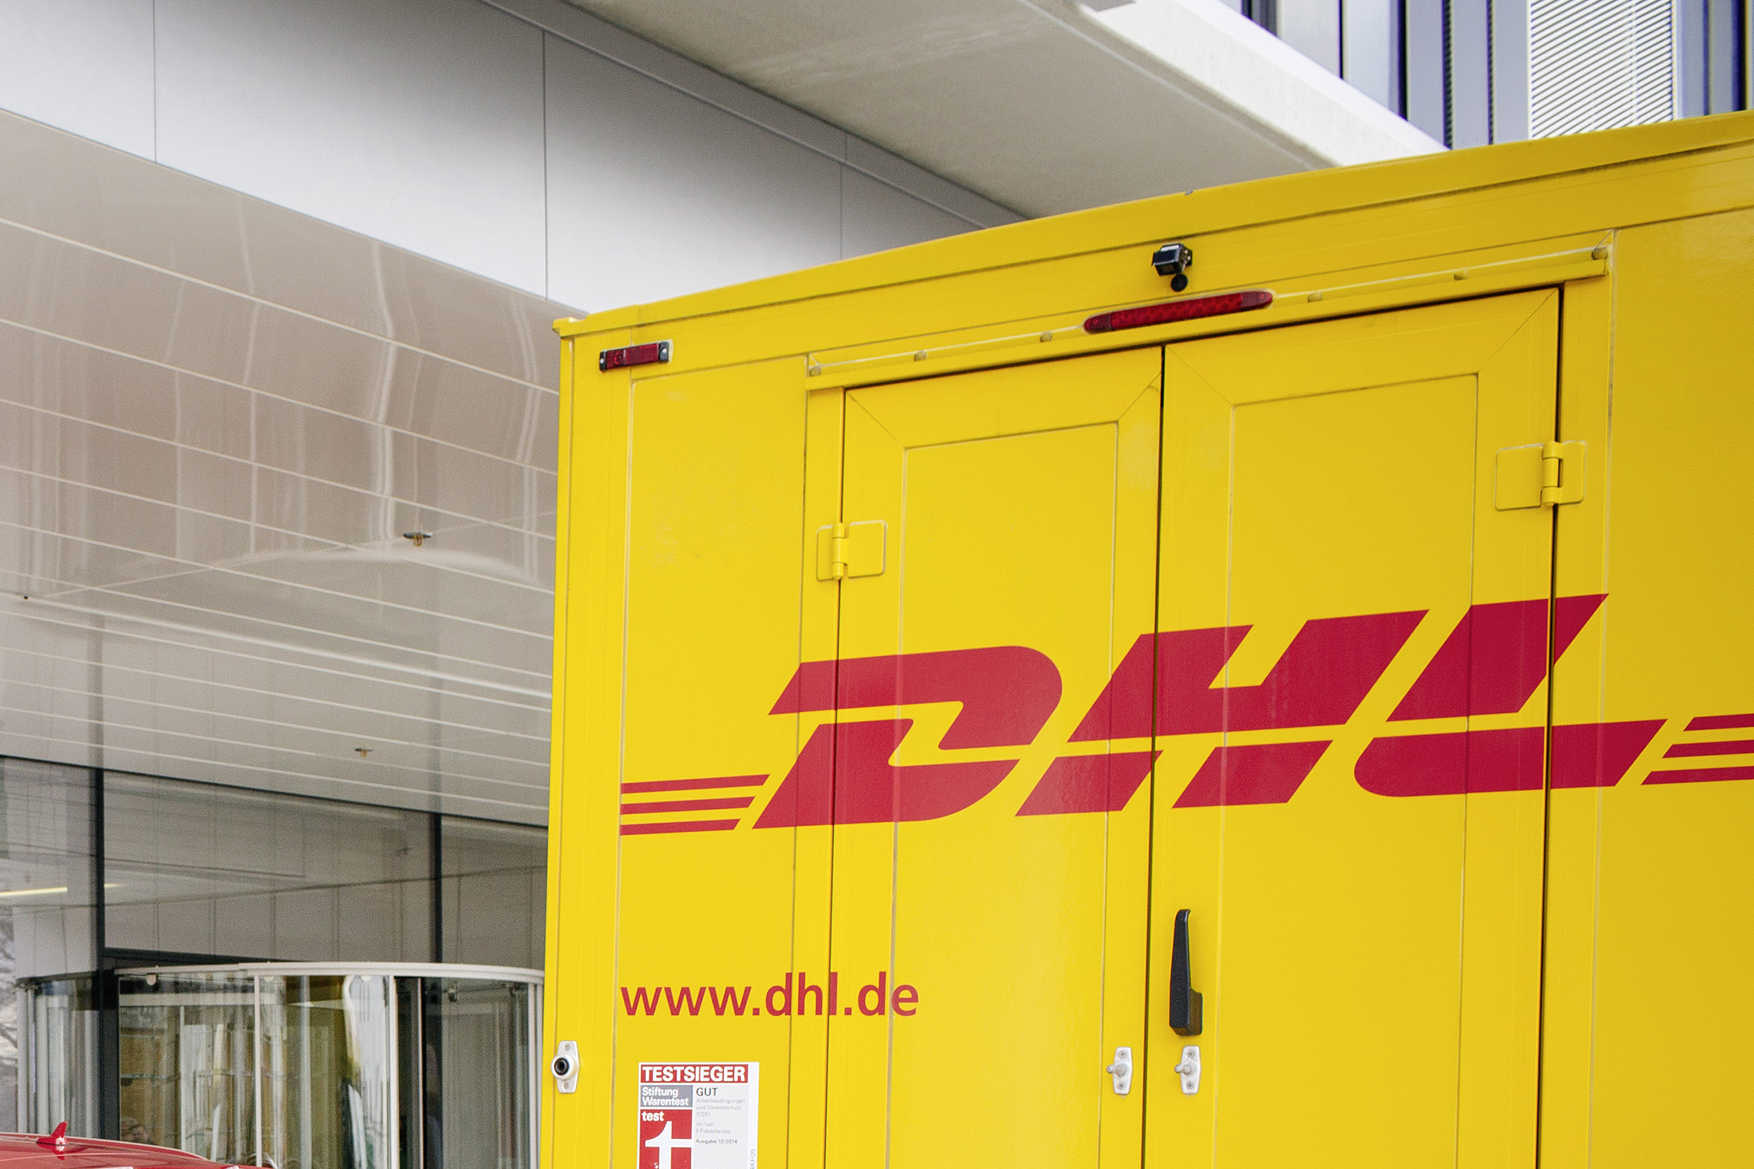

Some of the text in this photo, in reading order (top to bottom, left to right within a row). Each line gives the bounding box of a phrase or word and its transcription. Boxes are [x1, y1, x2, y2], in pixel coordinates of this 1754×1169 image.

[752, 593, 1667, 829] DHL
[620, 971, 919, 1016] www.dhl.de
[641, 1066, 746, 1082] TESTSIEGER
[642, 1087, 679, 1098] Stiftung
[696, 1087, 718, 1096] GUT
[642, 1097, 689, 1106] Warentest
[642, 1111, 664, 1121] test
